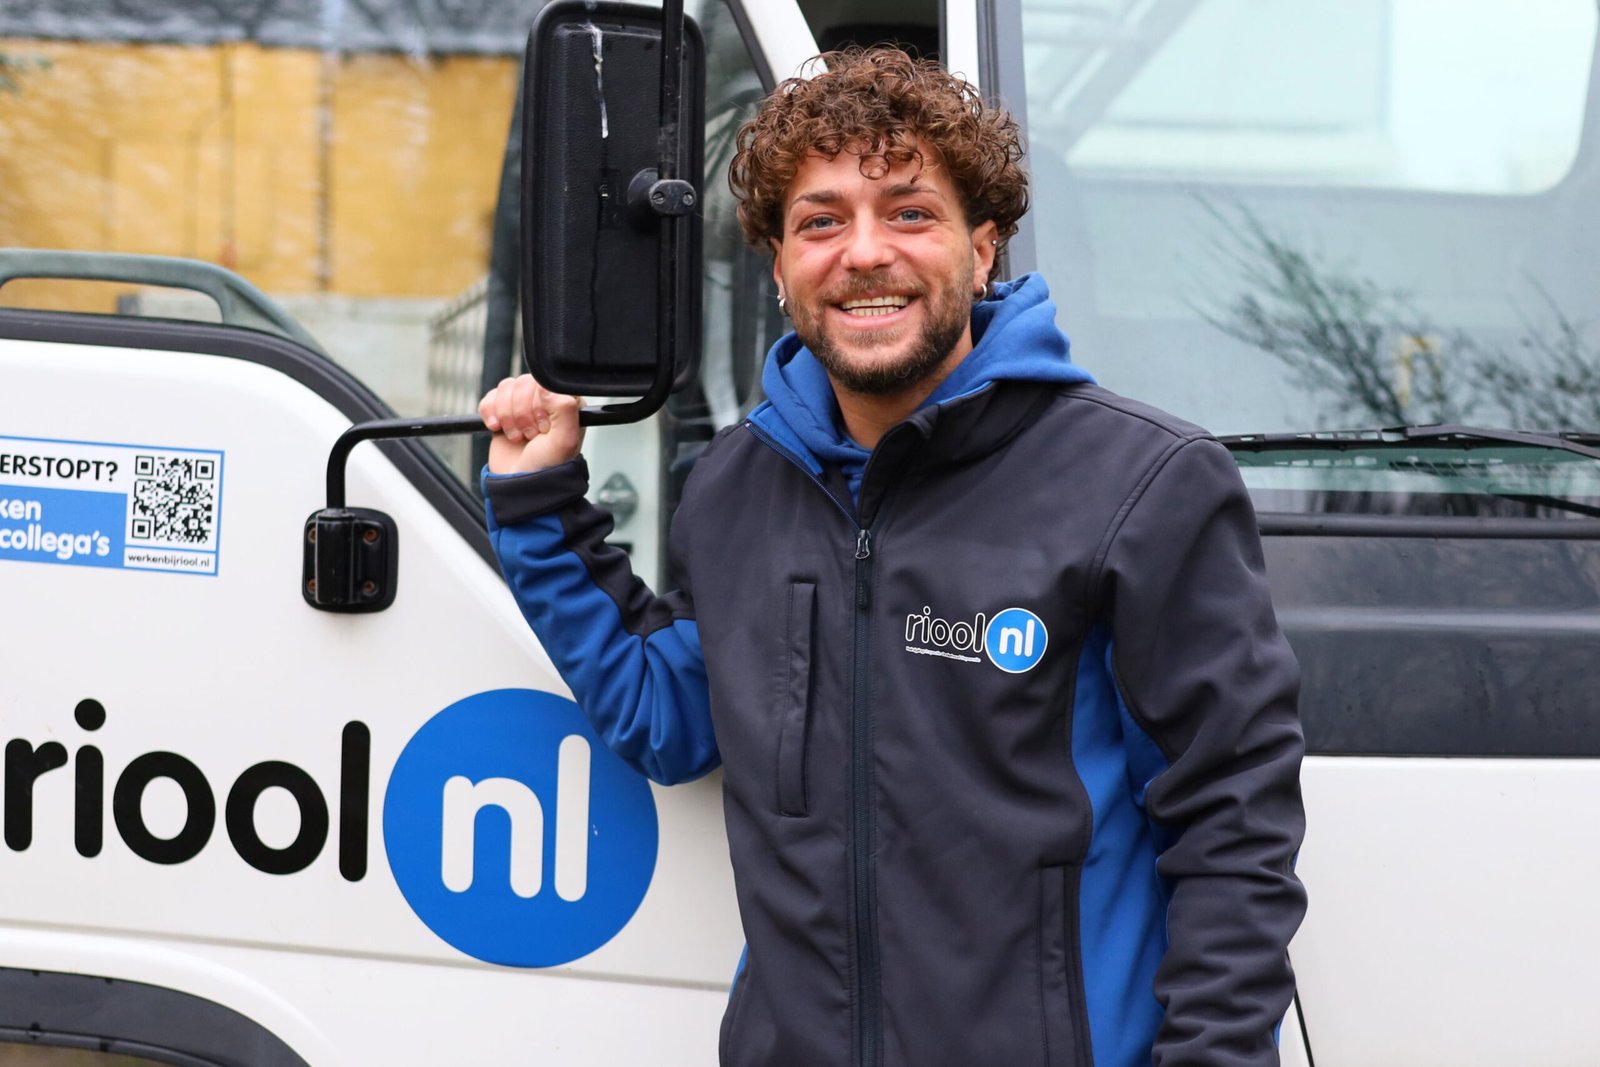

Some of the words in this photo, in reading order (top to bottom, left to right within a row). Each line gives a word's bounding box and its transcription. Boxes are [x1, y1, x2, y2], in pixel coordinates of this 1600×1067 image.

[0, 454, 118, 482] ERSTOPT?
[0, 523, 110, 560] collega's
[128, 554, 210, 567] werkenbijriool.nl
[905, 605, 986, 653] riool
[999, 618, 1035, 657] nl
[3, 698, 371, 882] riool
[441, 733, 591, 902] nl
